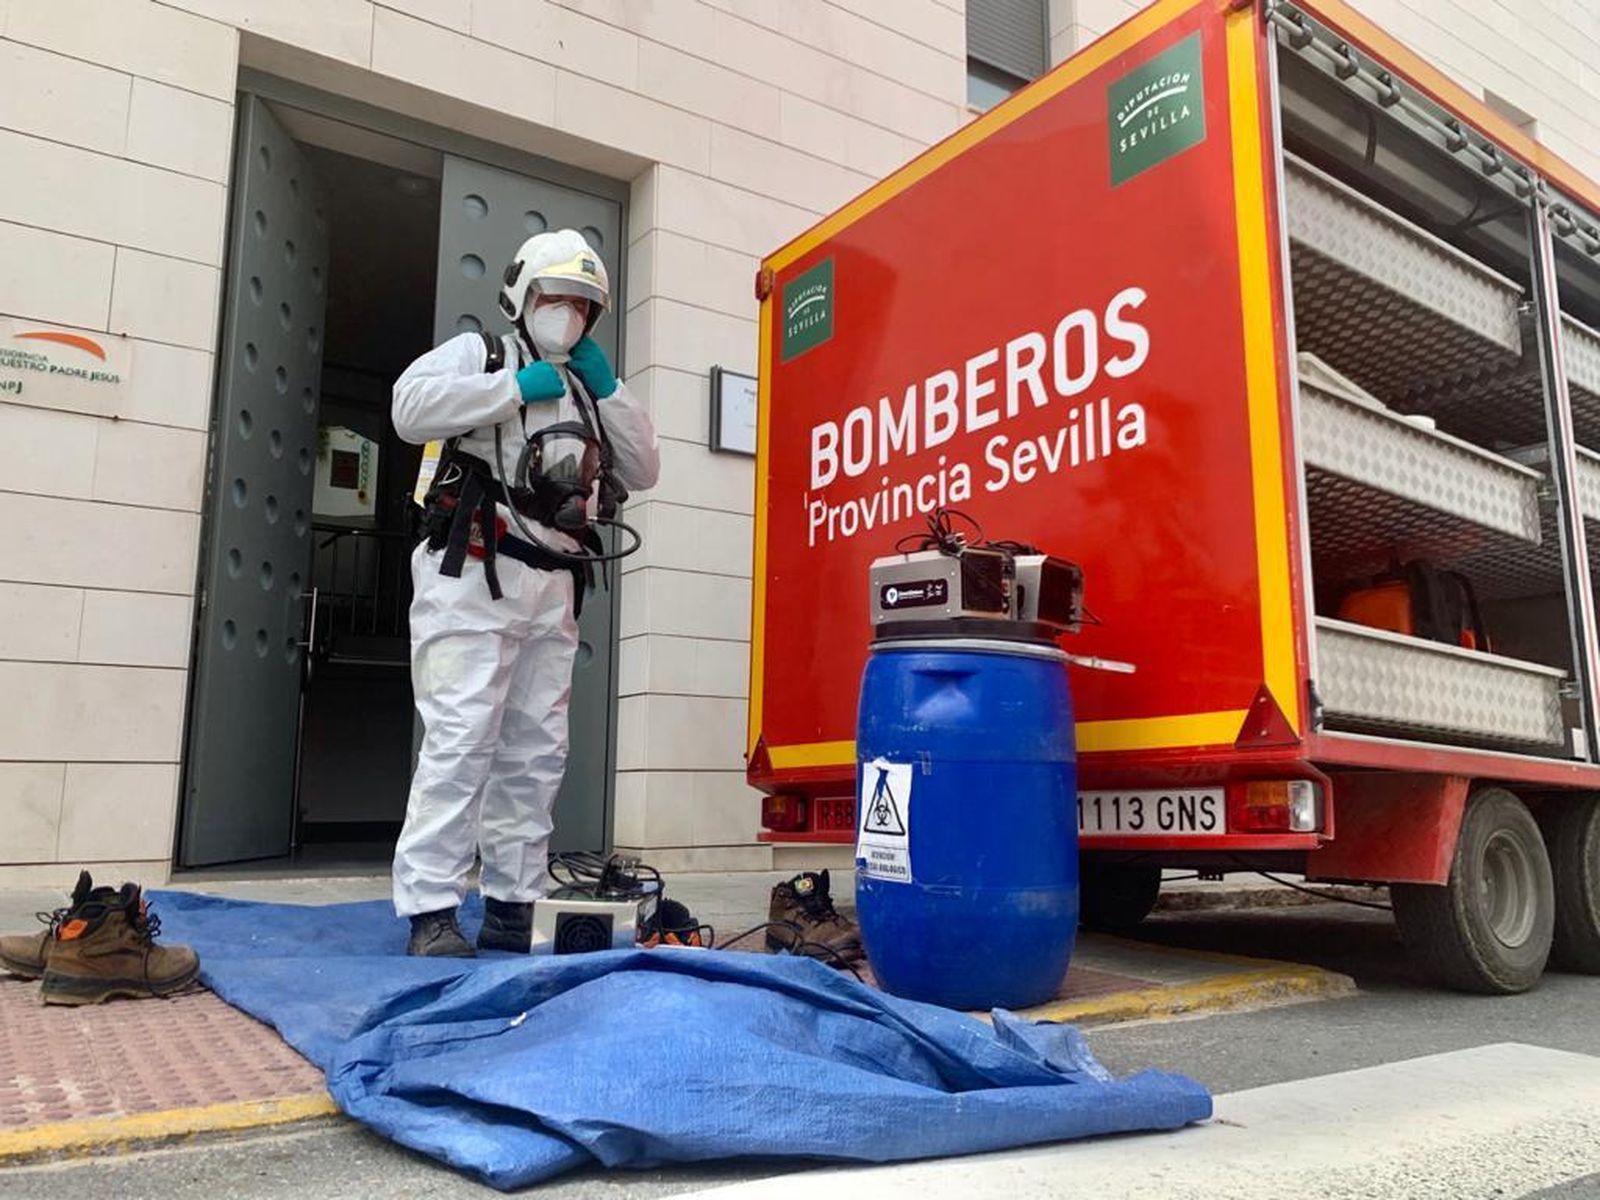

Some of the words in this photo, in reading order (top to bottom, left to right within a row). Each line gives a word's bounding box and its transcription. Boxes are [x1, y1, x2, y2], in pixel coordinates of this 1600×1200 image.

[1119, 105, 1191, 153] SEVILLA
[0, 357, 48, 372] UESTRO
[49, 364, 89, 379] PADRE
[90, 370, 120, 384] JESUS
[810, 286, 1151, 491] BOMBEROS
[808, 455, 972, 548] Provincia
[984, 396, 1147, 492] Sevilla
[1077, 796, 1145, 831] 1113
[1157, 795, 1217, 831] GNS
